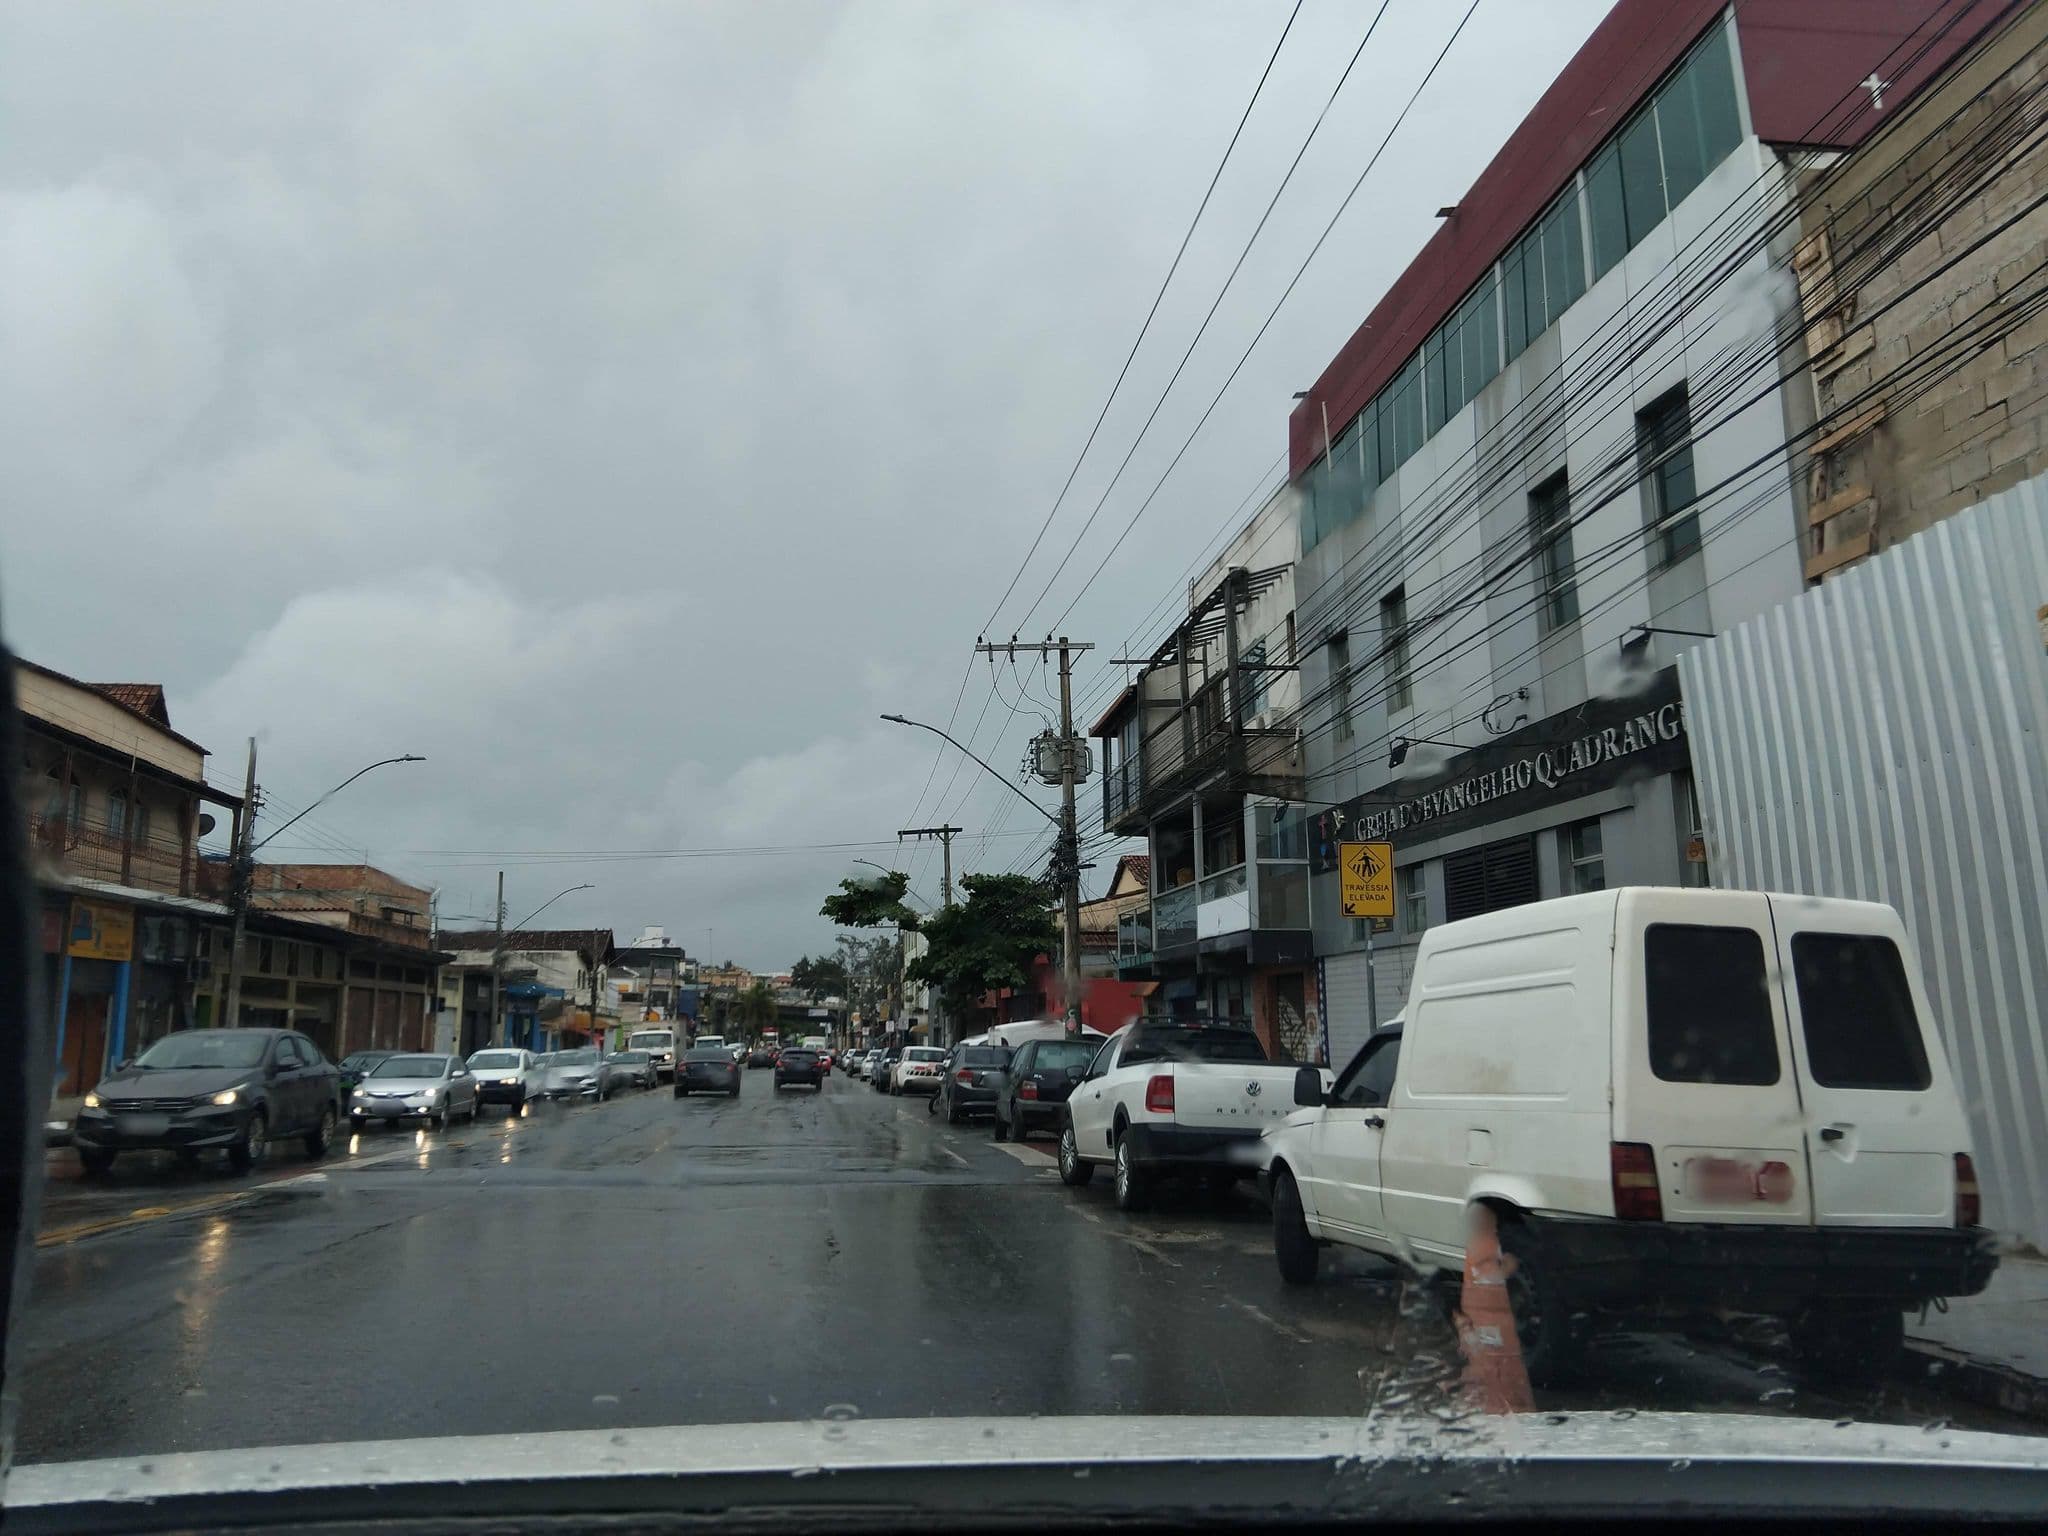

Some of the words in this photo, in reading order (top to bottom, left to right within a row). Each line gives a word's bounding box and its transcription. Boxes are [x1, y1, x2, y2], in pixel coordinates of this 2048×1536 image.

[1353, 808, 1399, 841] IGREJA
[1399, 800, 1423, 829] DO
[1422, 759, 1533, 821] EVANGELHO
[1345, 884, 1390, 892] TRAVESSIA
[1349, 893, 1386, 901] ELEVADA
